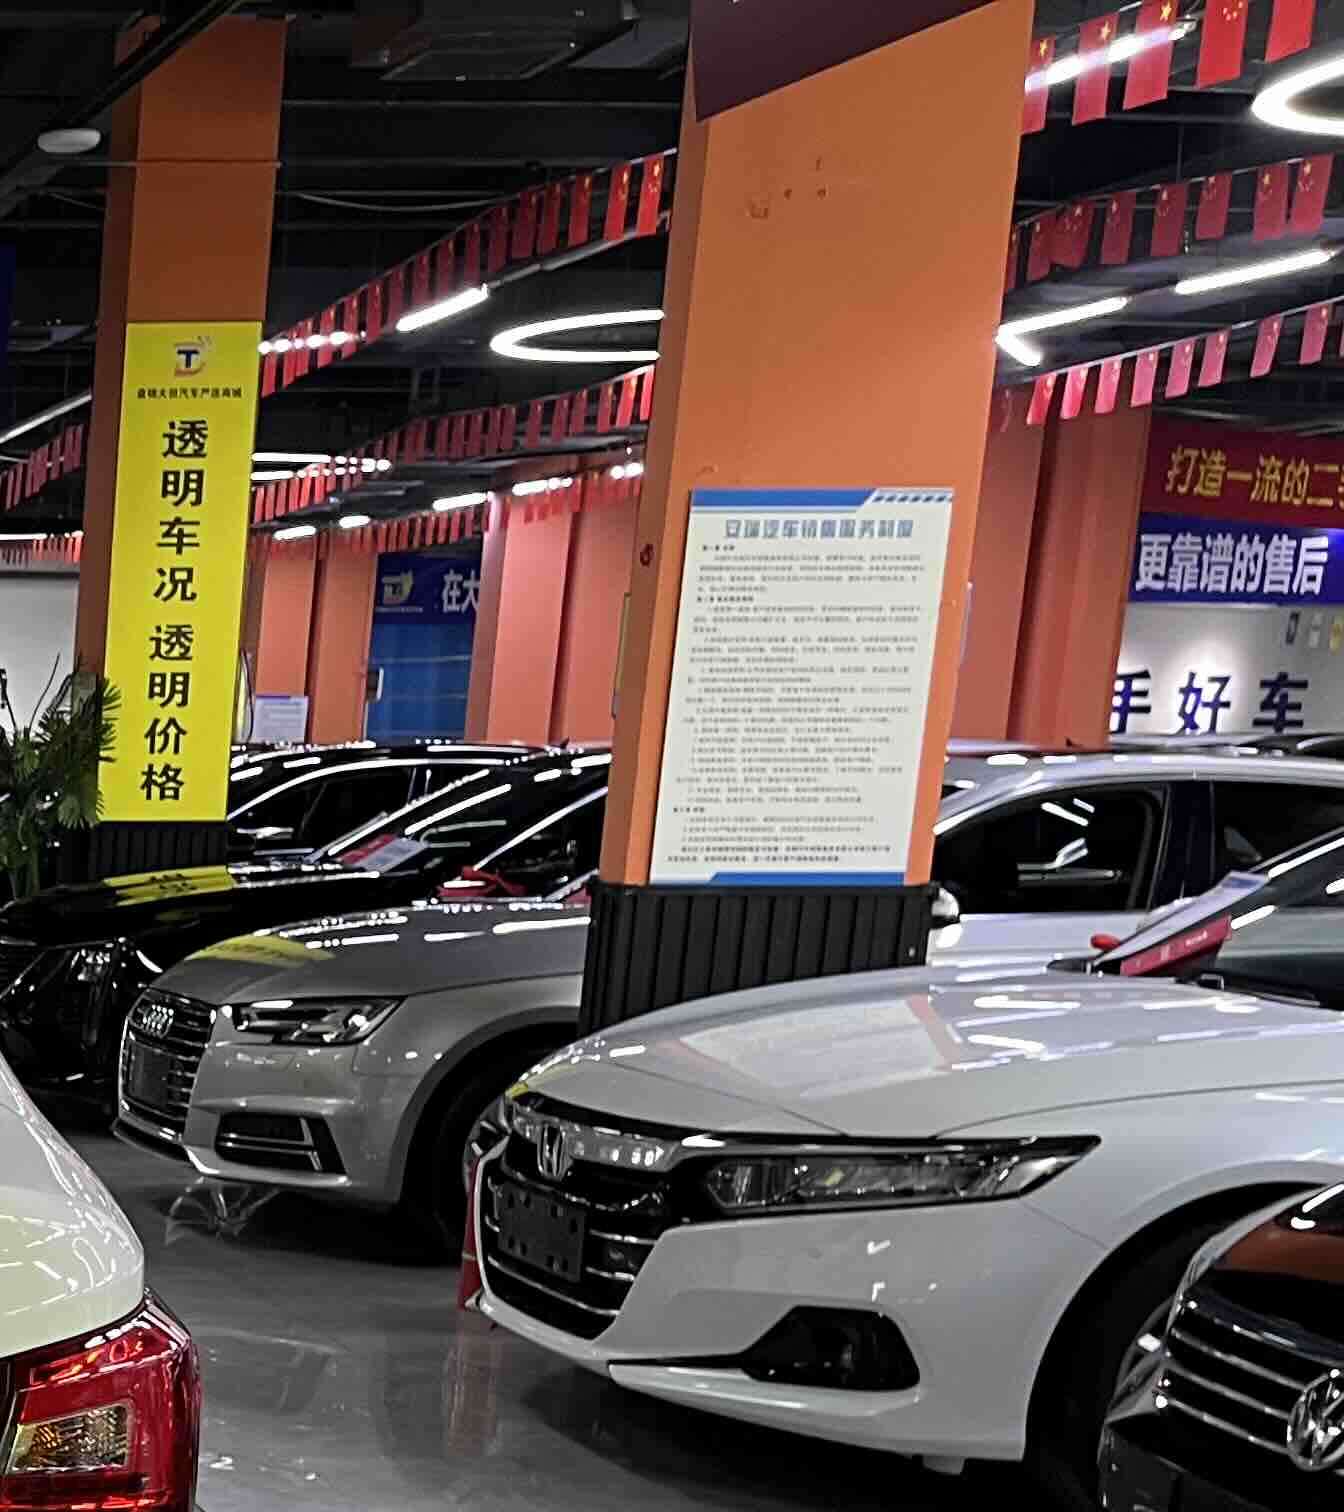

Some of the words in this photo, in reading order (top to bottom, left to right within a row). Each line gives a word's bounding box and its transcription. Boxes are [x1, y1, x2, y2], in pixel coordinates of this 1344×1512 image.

[152, 419, 210, 603] 透明车况
[1165, 446, 1344, 508] 打造一流的二
[1135, 532, 1329, 596] 更靠谱的售后
[139, 624, 195, 802] 透明价格
